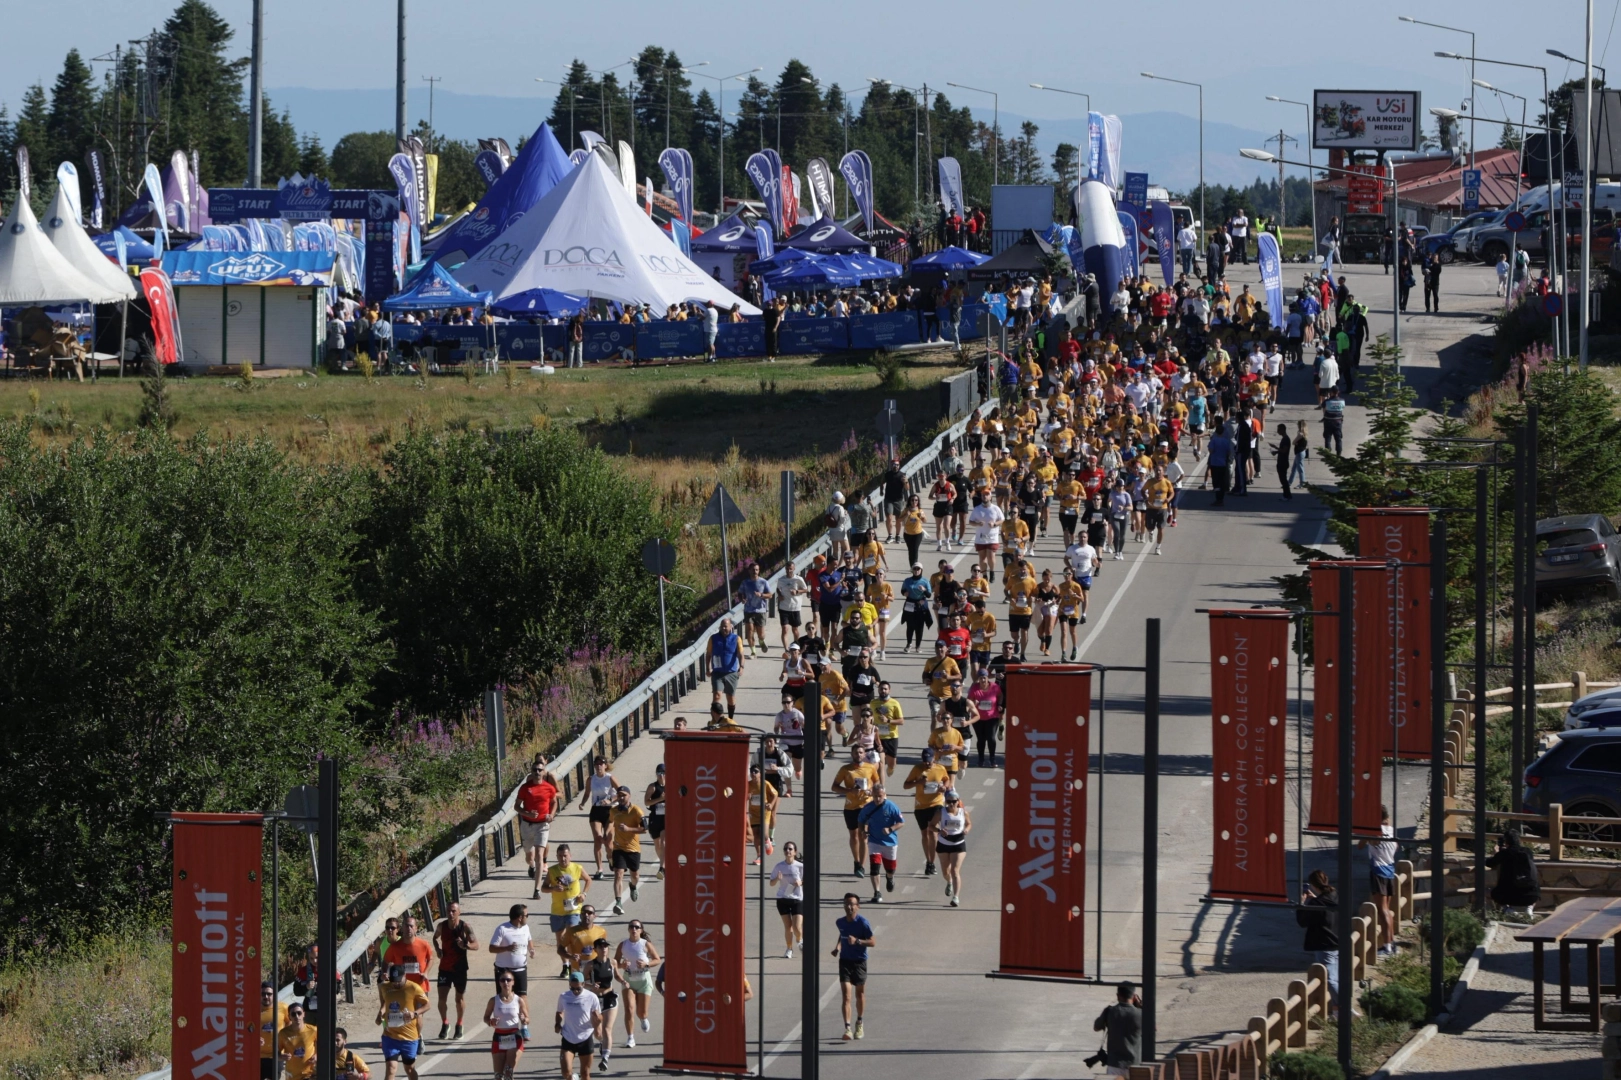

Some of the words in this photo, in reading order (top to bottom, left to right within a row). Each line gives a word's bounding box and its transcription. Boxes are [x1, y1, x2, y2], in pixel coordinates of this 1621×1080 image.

[1374, 123, 1404, 131] MERKEZİ
[1353, 166, 1376, 176] CAFE
[1465, 172, 1475, 185] P
[238, 199, 271, 209] START
[280, 189, 331, 212] Uludağ
[333, 199, 366, 209] START
[1467, 190, 1475, 199] D
[211, 204, 235, 212] ULUDAĞ
[859, 229, 894, 237] SMITH
[477, 242, 525, 266] DOCA
[544, 246, 624, 266] DOCA
[640, 254, 695, 274] DOCA
[217, 263, 276, 275] UPUT
[1235, 637, 1248, 750] COLLECTION
[1255, 726, 1265, 787] HOTELS
[1018, 728, 1058, 904] Marriott
[1061, 748, 1074, 874] INTERNATIONAL
[1235, 759, 1248, 871] AUTOGRAPH
[695, 763, 718, 916] SPLEND'OR
[234, 912, 245, 1062] INTERNATIONAL
[694, 927, 716, 1034] CEYLAN
